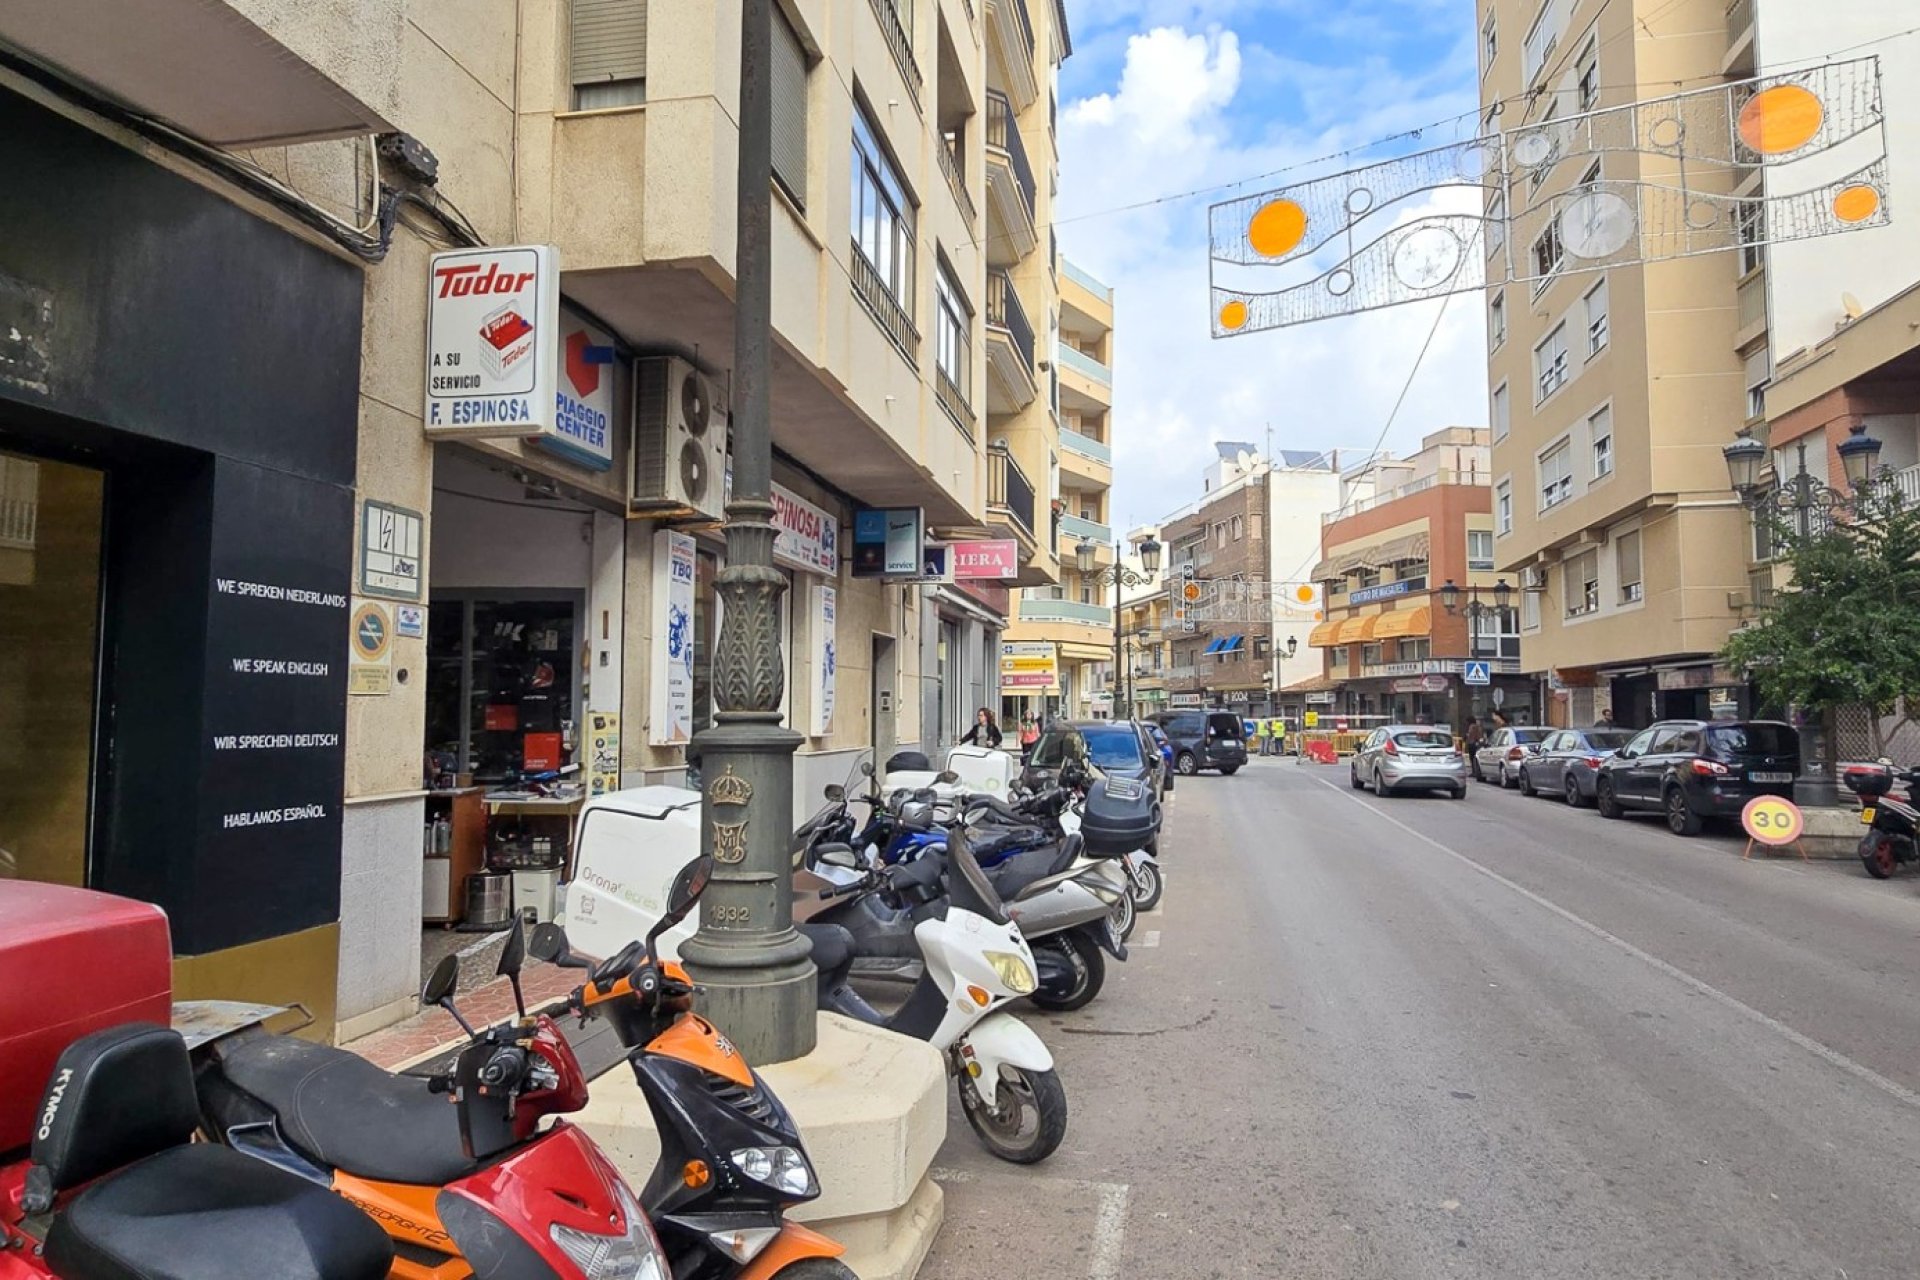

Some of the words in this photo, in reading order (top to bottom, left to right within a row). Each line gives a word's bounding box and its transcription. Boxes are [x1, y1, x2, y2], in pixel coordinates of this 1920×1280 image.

[435, 263, 535, 298] Tudor
[433, 353, 441, 367] A
[446, 353, 461, 367] SU
[432, 374, 481, 390] SERVICIO
[430, 402, 442, 425] F.
[451, 399, 529, 424] ESPINOSA
[556, 391, 606, 431] PIAGGIO
[556, 412, 604, 448] CENTER
[672, 560, 692, 581] TBQ
[888, 561, 914, 569] service
[216, 578, 236, 594] WE
[237, 581, 284, 600] SPREKEN
[286, 588, 347, 608] NEDERLANDS
[232, 658, 252, 672] WE
[253, 659, 286, 674] SPEAK
[287, 661, 328, 676] ENGLISH
[213, 736, 237, 750] WIR
[239, 734, 293, 749] SPRECHEN
[294, 733, 338, 747] DEUTSCH
[223, 808, 282, 829] HABLAMOS
[283, 803, 326, 822] ESPAÑOL
[1753, 811, 1791, 829] 30
[711, 905, 750, 921] 1832
[38, 1068, 74, 1141] KYMCO
